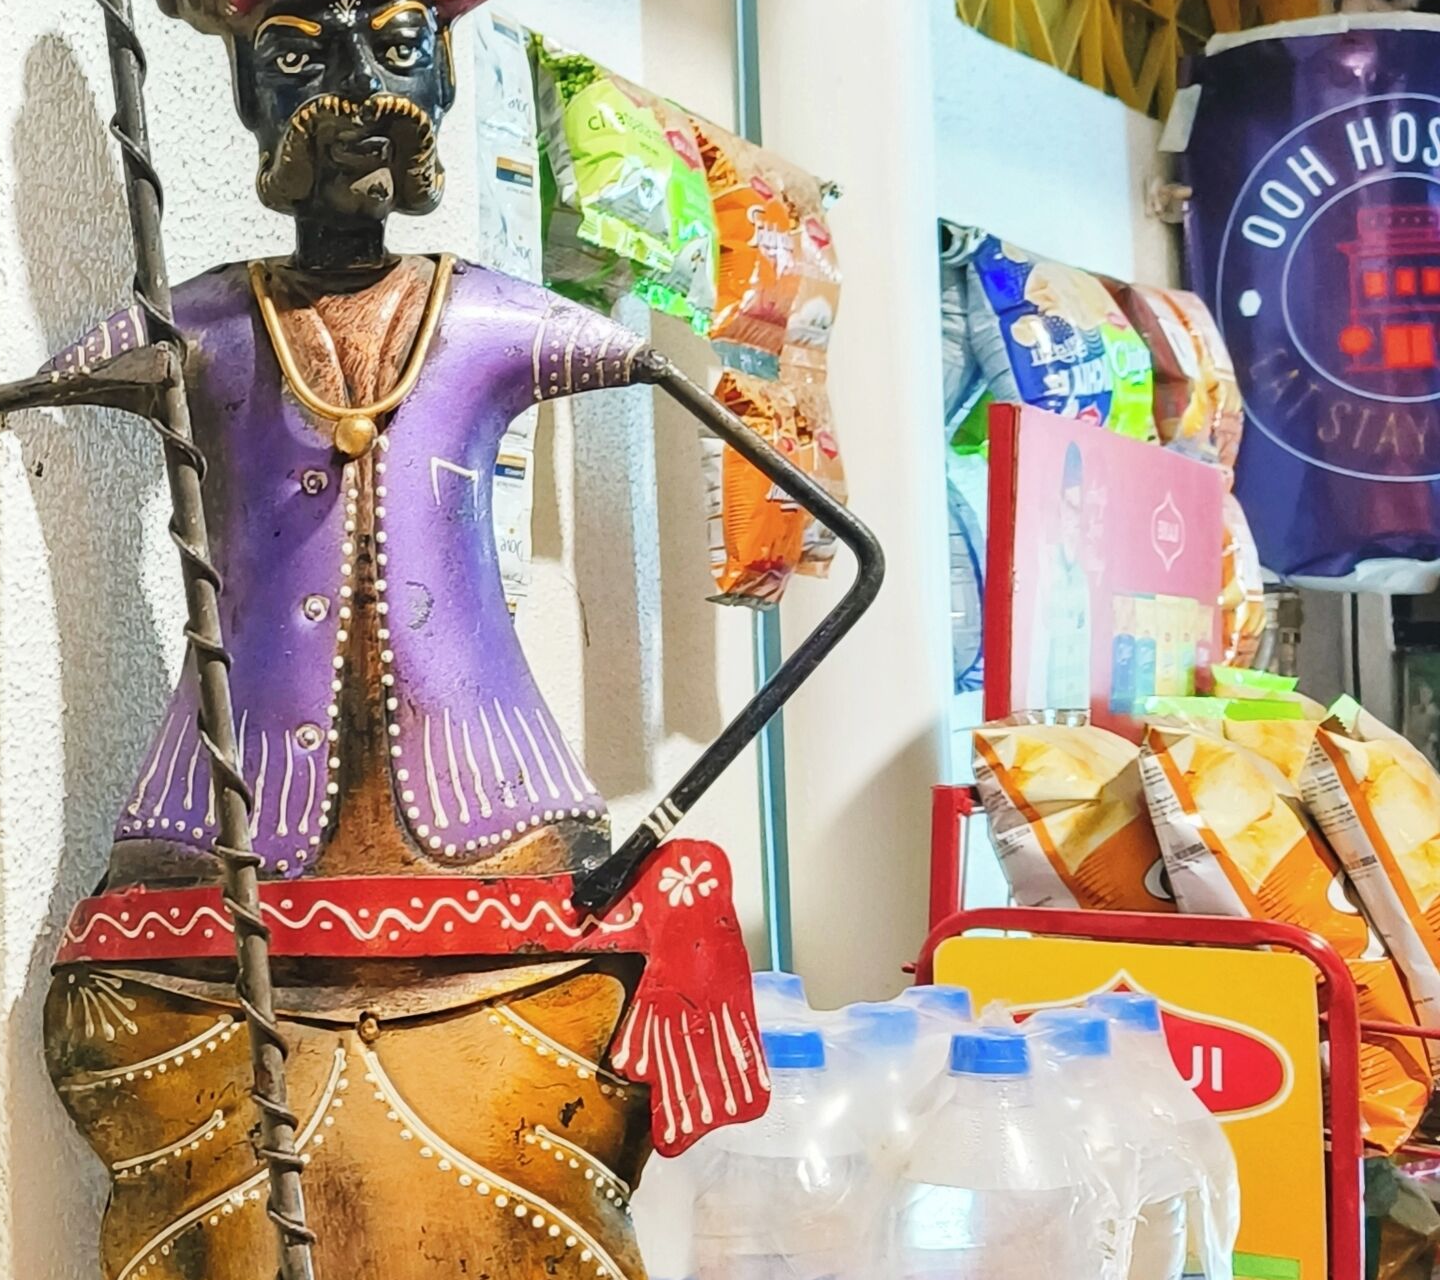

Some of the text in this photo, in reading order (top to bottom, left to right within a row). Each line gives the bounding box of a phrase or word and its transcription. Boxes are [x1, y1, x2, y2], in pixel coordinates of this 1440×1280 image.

[1241, 111, 1440, 250] OOH HOS
[1317, 401, 1431, 456] STAY
